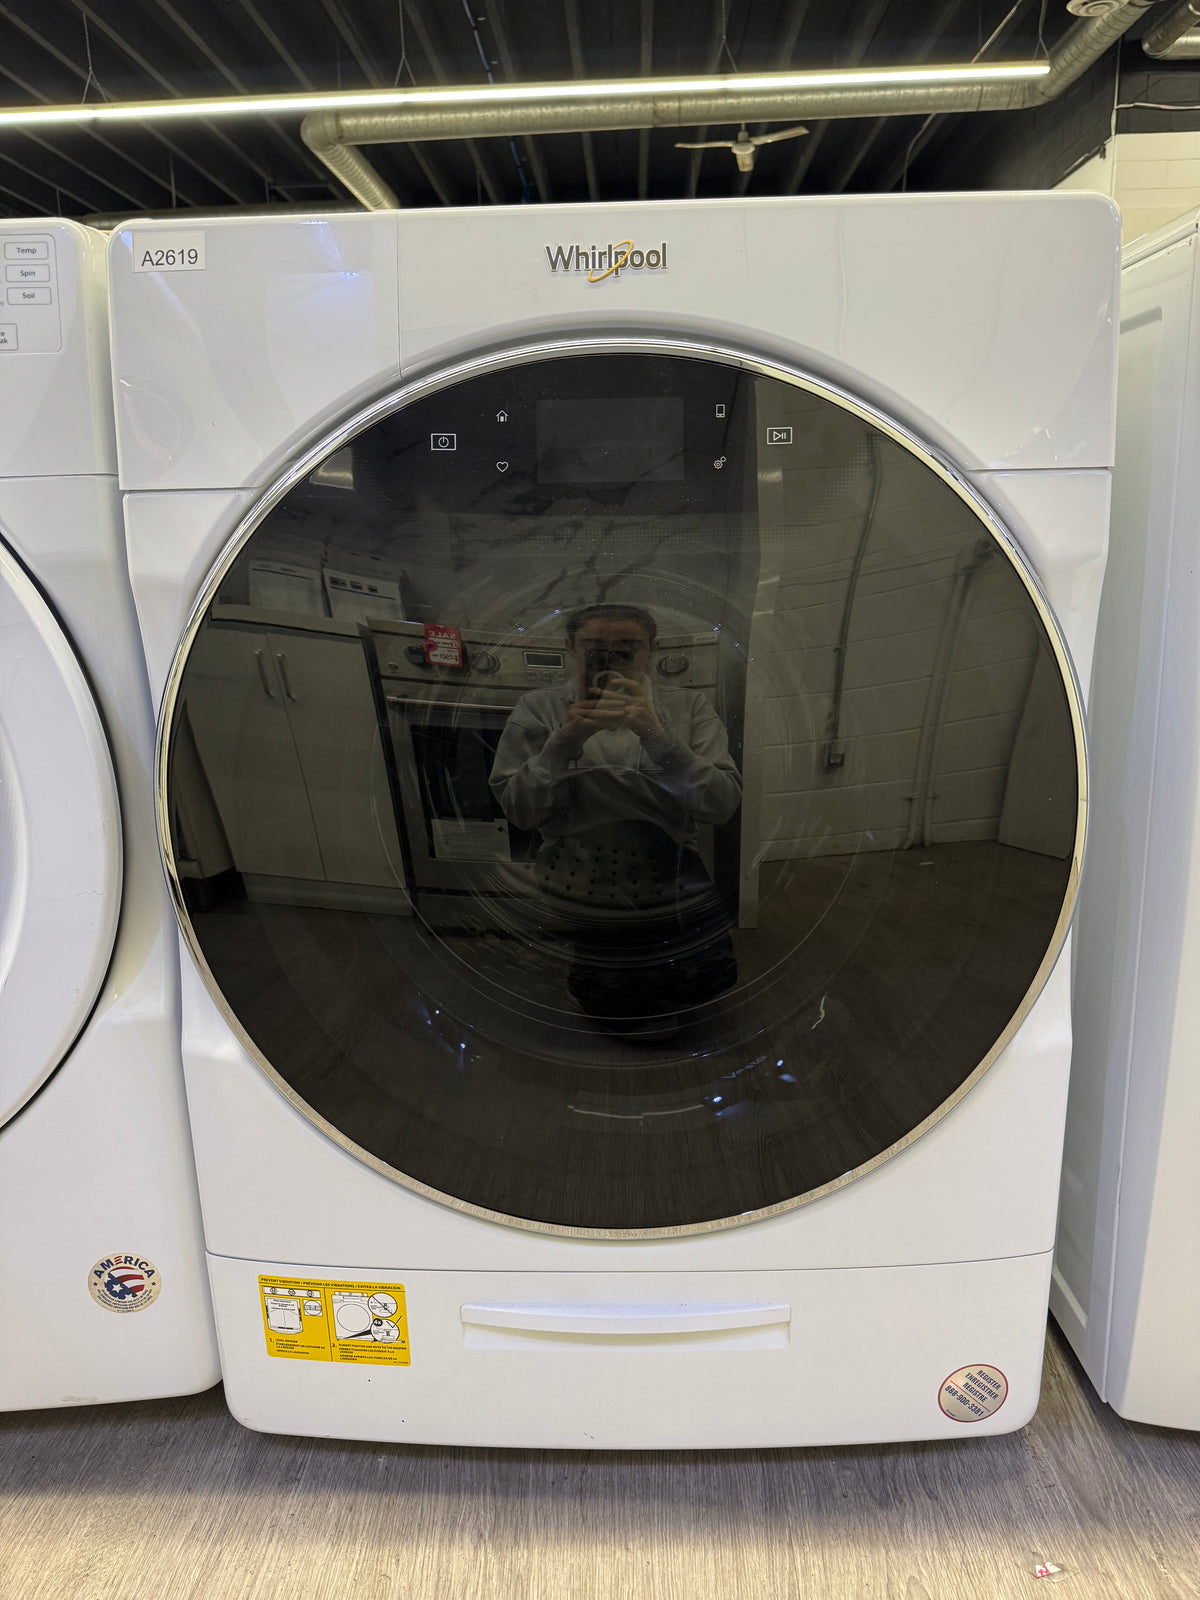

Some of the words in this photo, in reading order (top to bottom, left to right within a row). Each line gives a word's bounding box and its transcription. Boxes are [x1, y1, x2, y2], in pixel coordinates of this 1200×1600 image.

[16, 247, 37, 255] Temp
[141, 248, 198, 267] A2619
[545, 242, 668, 276] Whirlpool
[20, 269, 36, 278] Spin
[93, 1255, 156, 1279] AMERICA
[965, 1373, 998, 1399] ENREGISTRER
[977, 1370, 1001, 1390] REGISTER
[945, 1385, 983, 1416] 888-900-3381
[963, 1383, 987, 1402] REGISTRE
